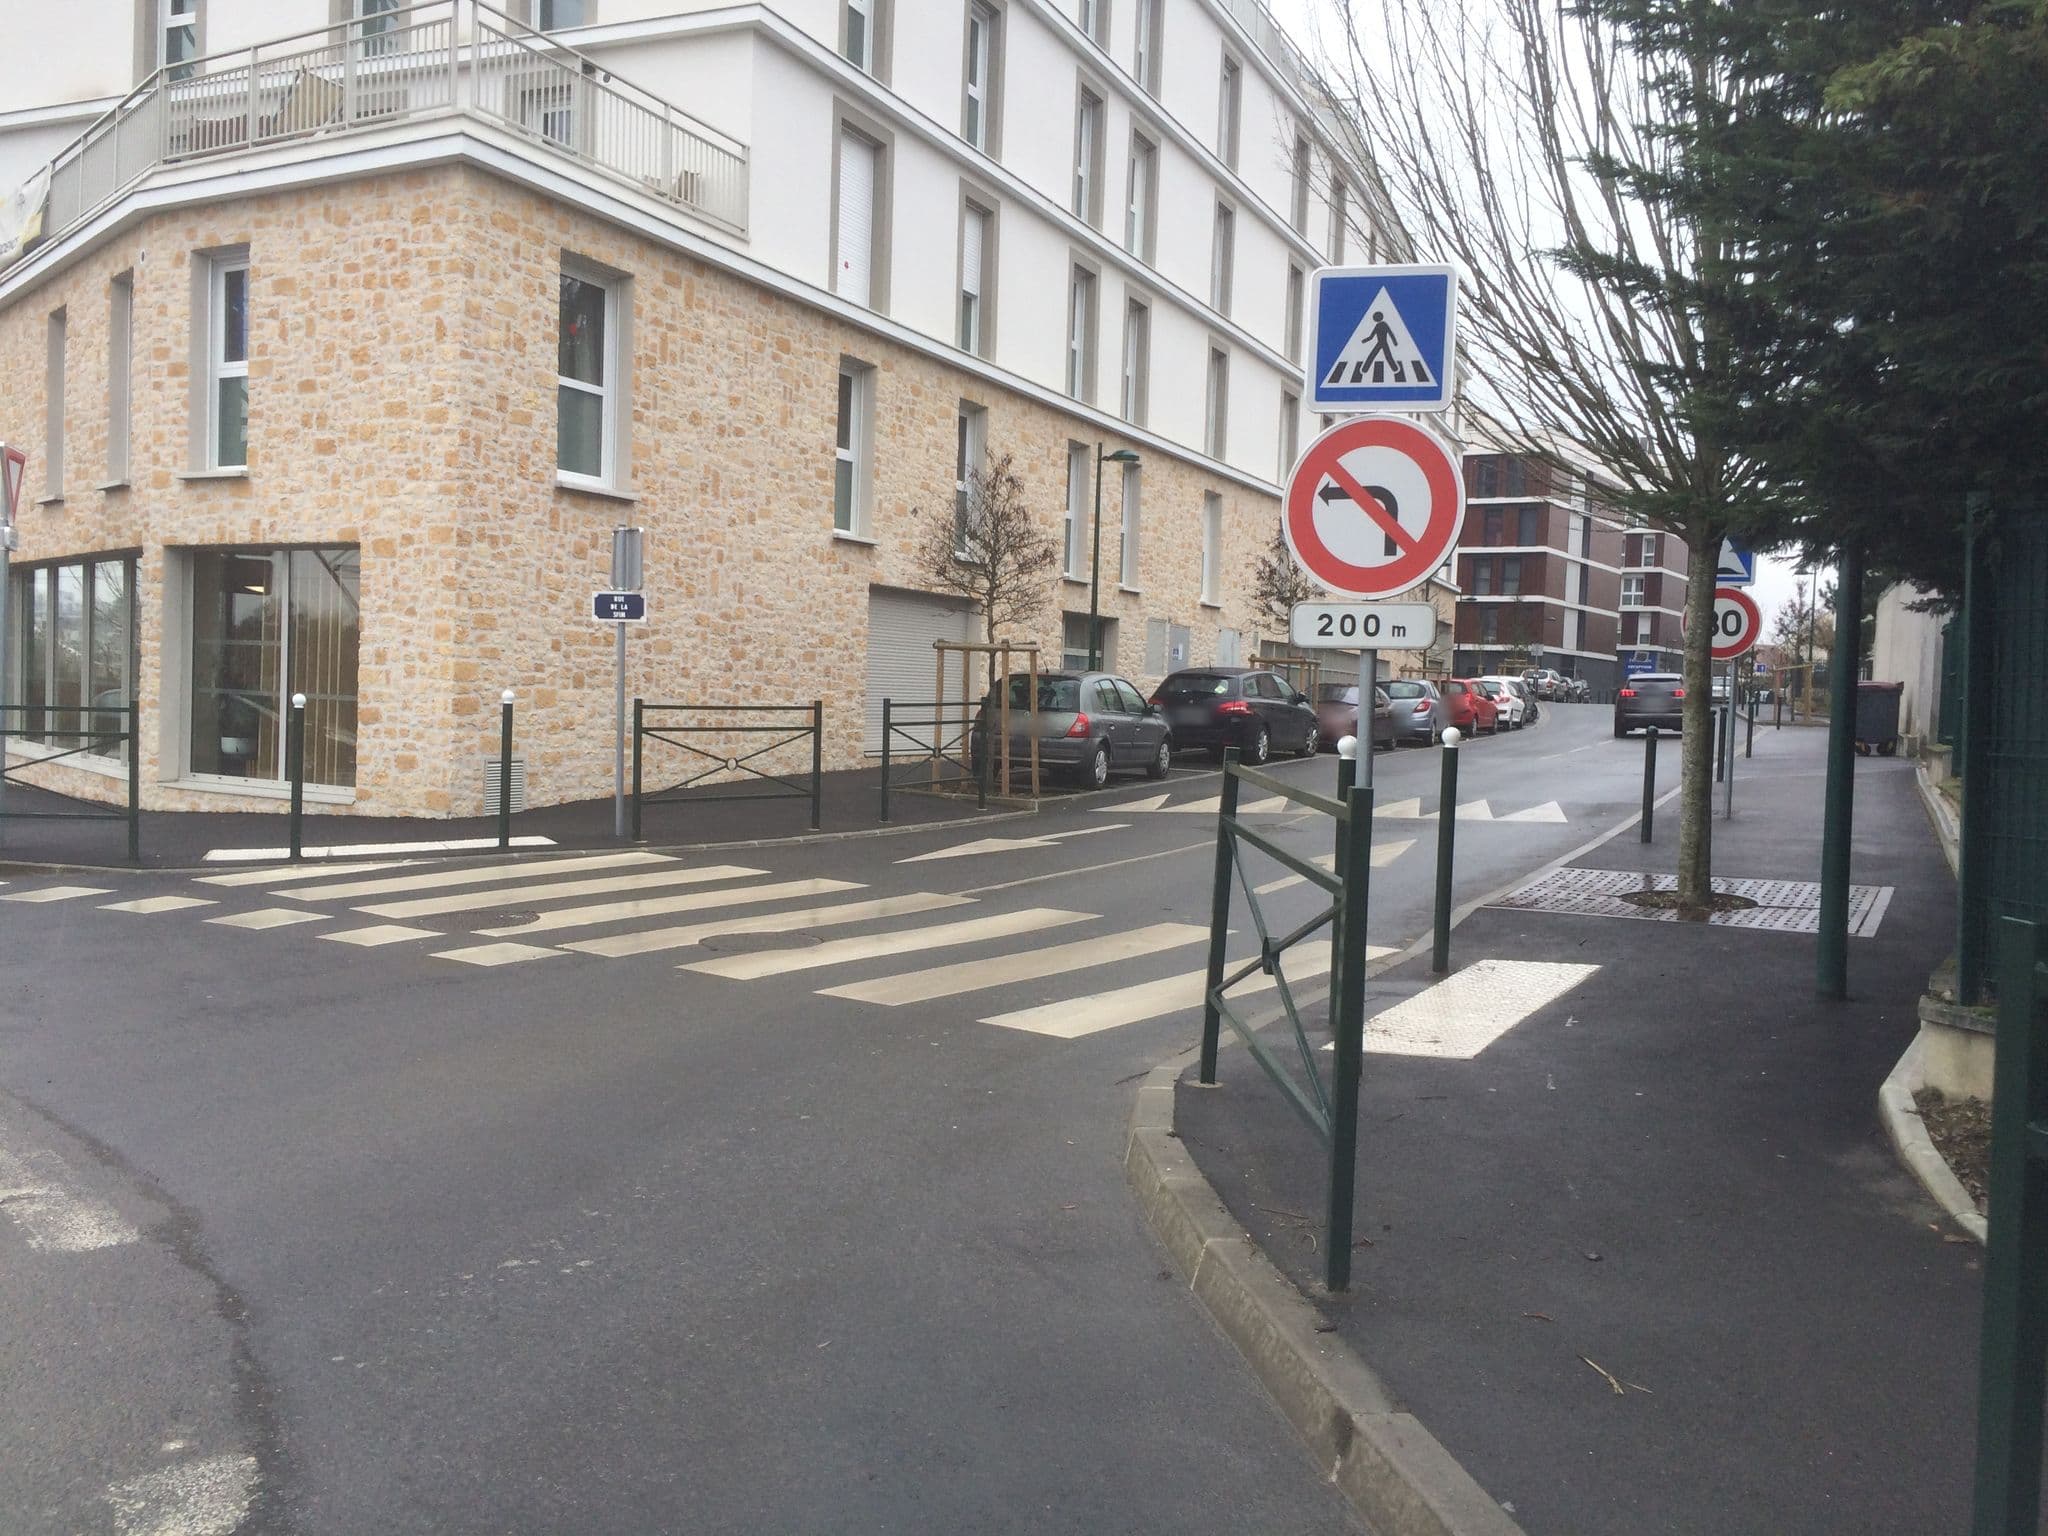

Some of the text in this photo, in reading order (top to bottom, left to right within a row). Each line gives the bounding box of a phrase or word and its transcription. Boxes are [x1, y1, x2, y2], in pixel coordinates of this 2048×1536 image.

[614, 595, 625, 603] RUE
[610, 603, 629, 611] DE LA
[1317, 613, 1407, 637] 200 m
